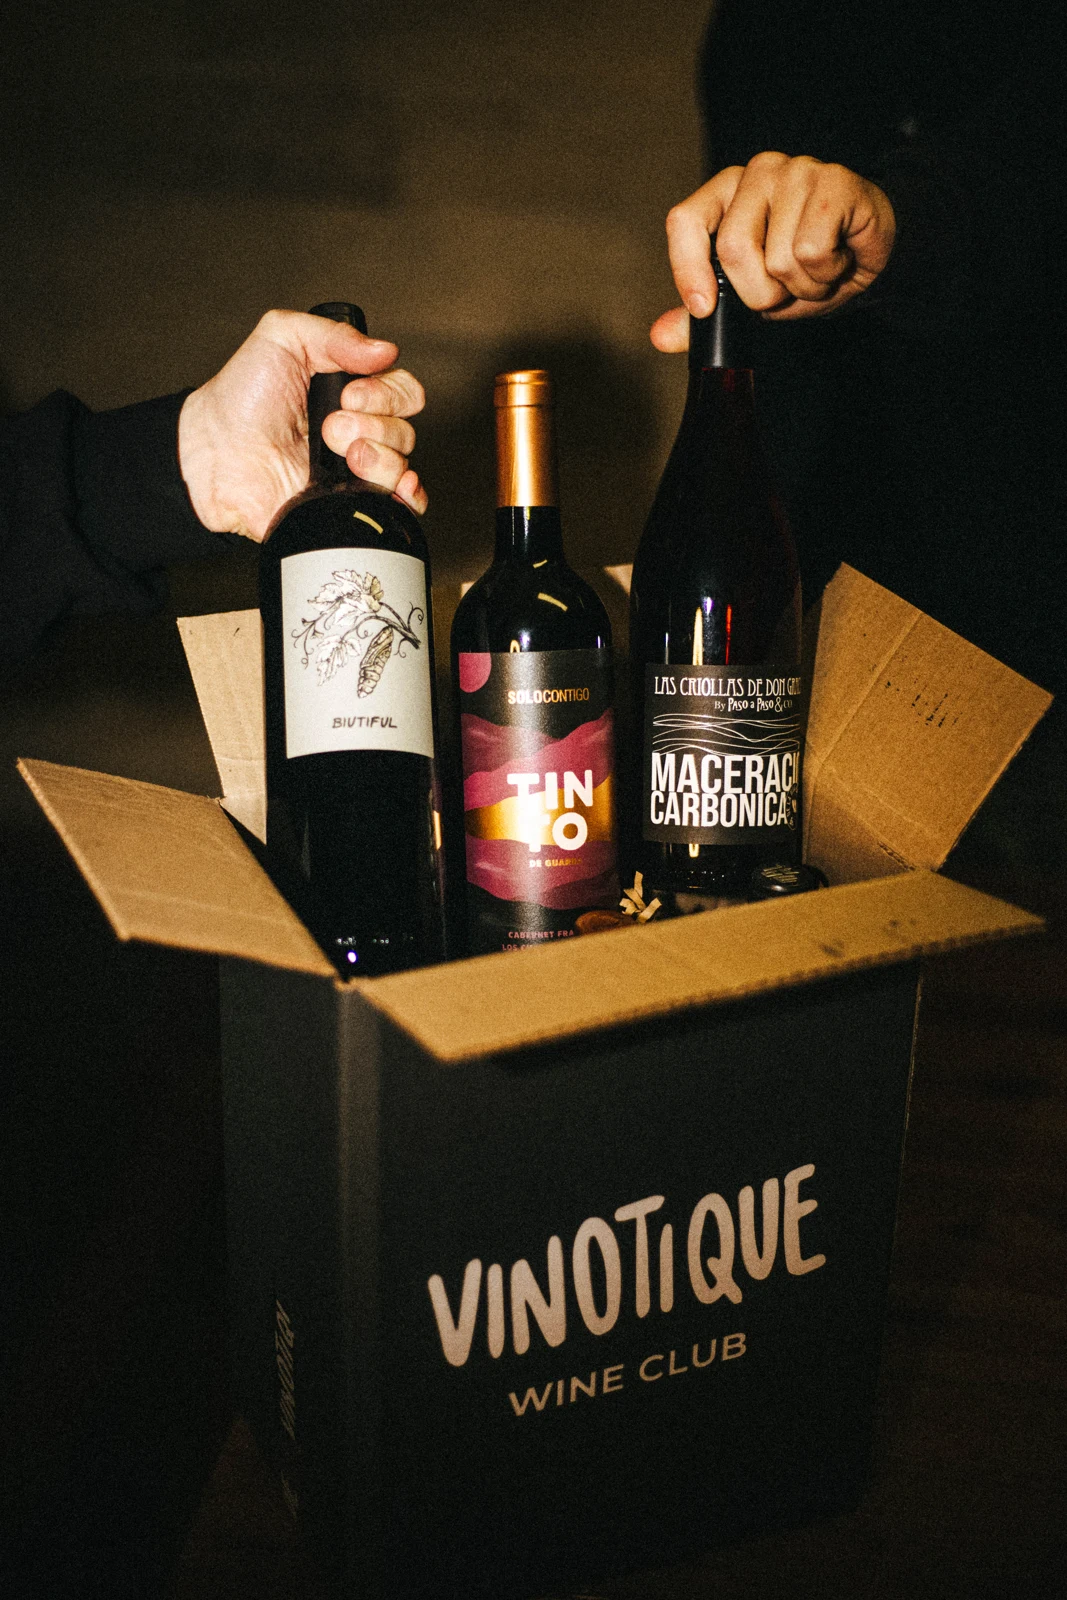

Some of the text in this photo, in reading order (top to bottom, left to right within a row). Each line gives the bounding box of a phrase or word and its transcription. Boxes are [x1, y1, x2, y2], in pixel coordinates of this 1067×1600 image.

[507, 687, 590, 705] SOLOCONTIGO
[654, 676, 677, 695] LAS
[680, 677, 744, 697] CRIOLLAS
[747, 678, 763, 697] DE
[766, 678, 785, 697] DON
[714, 700, 726, 712] By
[750, 701, 755, 709] a
[332, 715, 398, 729] BIUTIFUL
[507, 769, 594, 810] TIN
[650, 790, 788, 827] CARBONICA
[521, 811, 588, 853] TO
[529, 859, 542, 868] DE
[508, 930, 555, 939] CABERNET
[427, 1163, 826, 1367] VINOTIQUE
[508, 1332, 748, 1417] WINE CLUB
